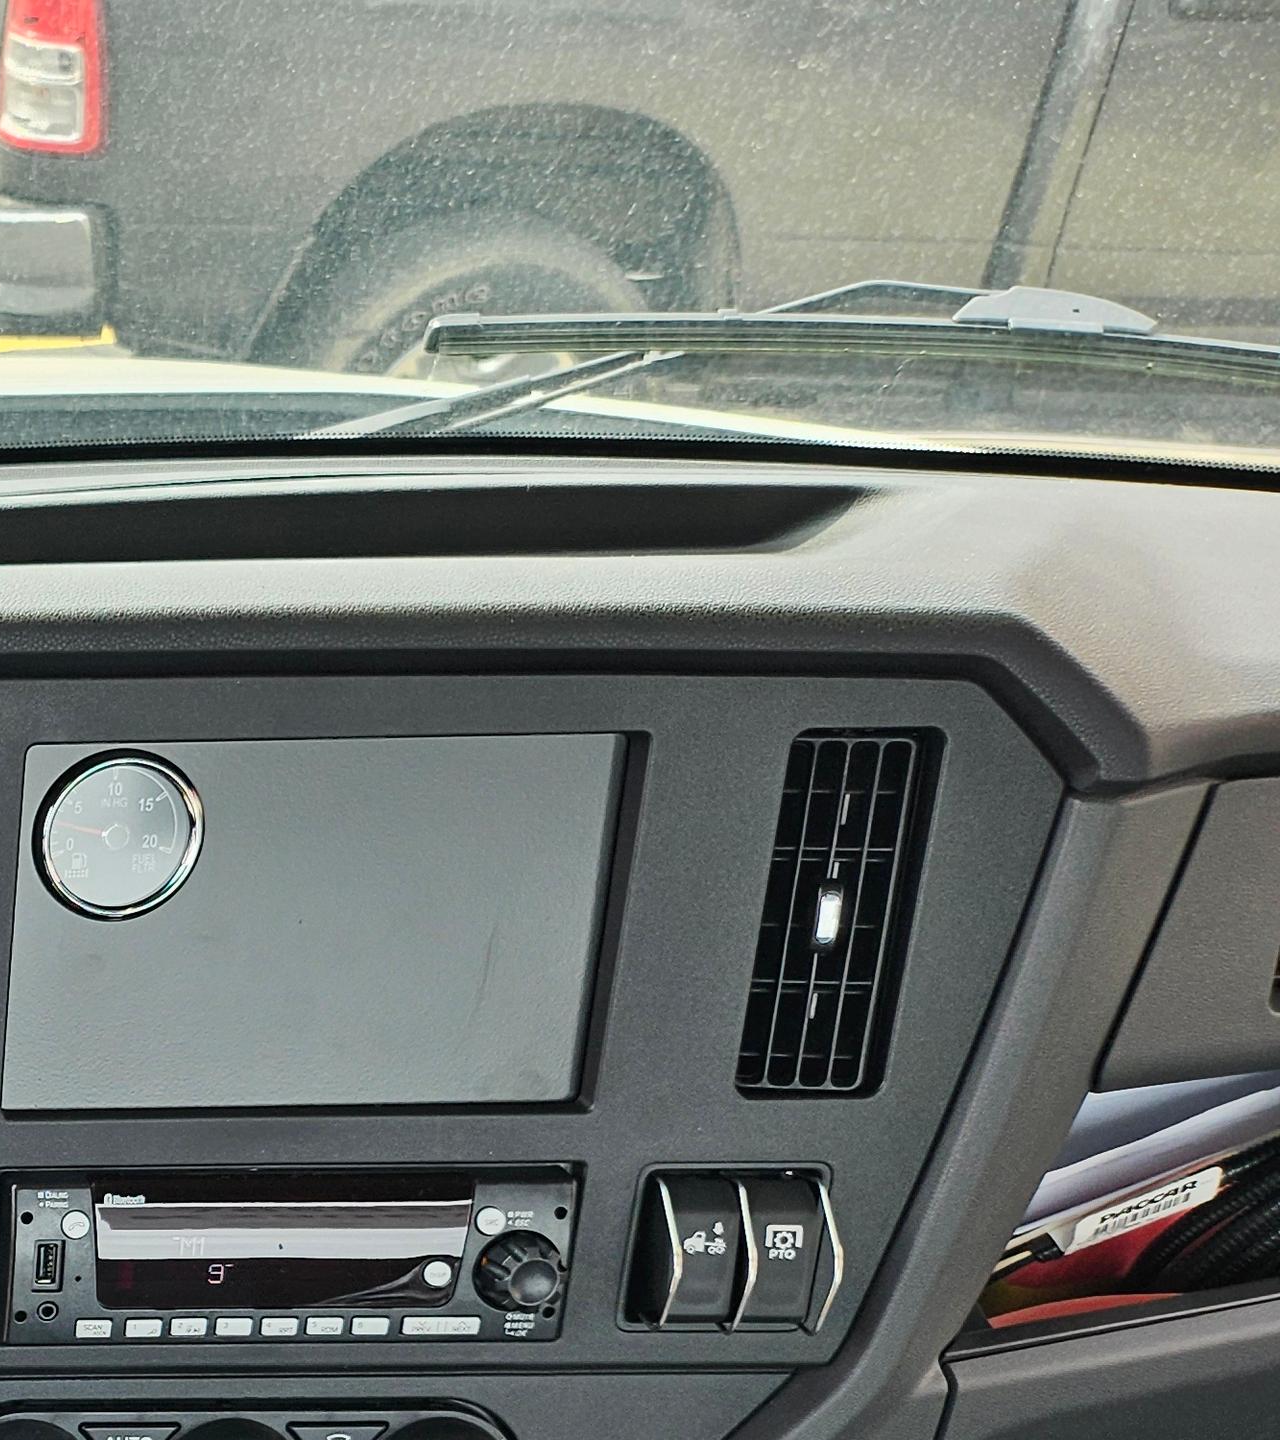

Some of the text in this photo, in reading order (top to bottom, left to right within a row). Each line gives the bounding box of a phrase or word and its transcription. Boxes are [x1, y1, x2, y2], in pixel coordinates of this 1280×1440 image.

[108, 782, 122, 796] 10
[74, 801, 83, 815] 5
[138, 799, 154, 812] 15
[66, 837, 75, 851] 0
[142, 835, 158, 849] 20
[1099, 1179, 1199, 1225] PACCAR
[768, 1249, 797, 1260] PTO
